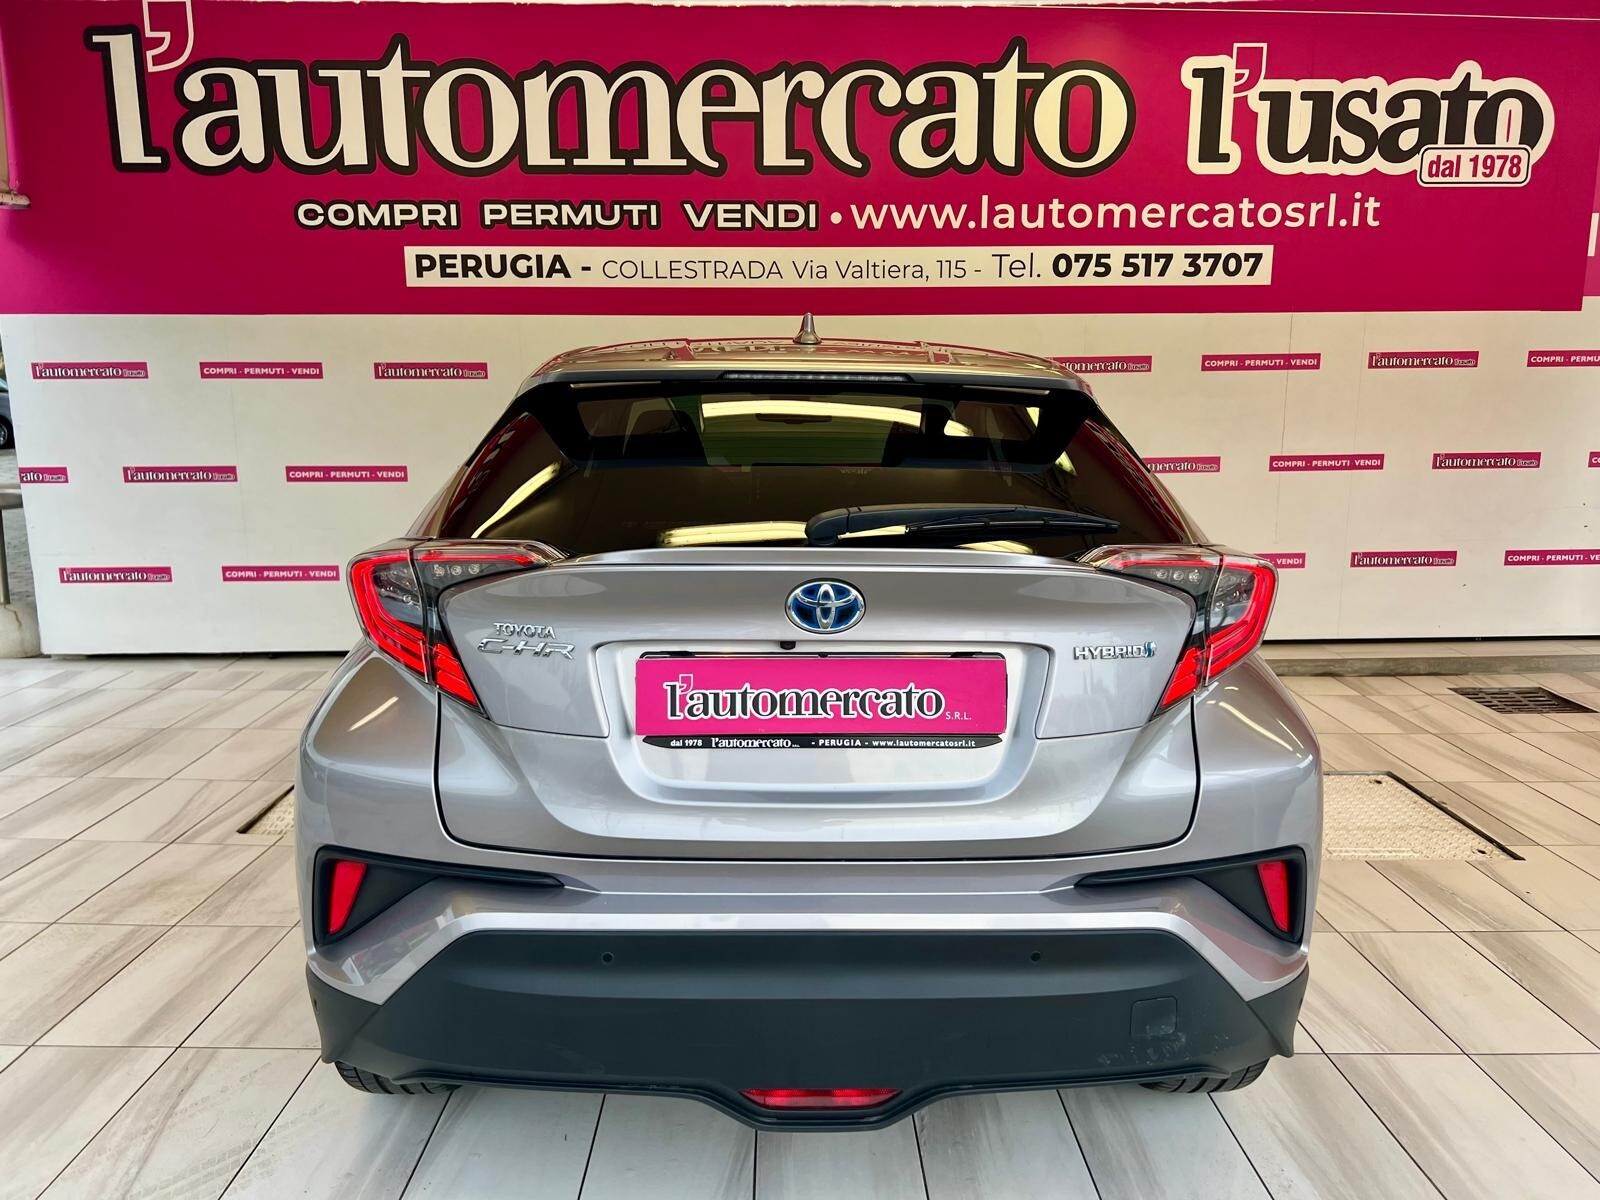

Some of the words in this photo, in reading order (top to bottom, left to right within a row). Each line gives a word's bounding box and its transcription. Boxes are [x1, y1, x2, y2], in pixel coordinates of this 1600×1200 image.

[88, 0, 1134, 172] l'automercato
[1185, 43, 1551, 170] l'usato
[1427, 157, 1461, 178] dal
[1469, 154, 1522, 178] 1978
[296, 201, 460, 229] COMPRI
[481, 202, 660, 228] PERMUTI
[682, 202, 818, 229] VENDI
[850, 192, 1381, 229] www.lautomercatosrl.it
[415, 253, 572, 279] PERUGIA
[602, 260, 784, 280] COLLESTRADA
[792, 259, 828, 279] Via
[835, 259, 930, 283] Valtiera,
[936, 259, 967, 279] 115
[991, 251, 1042, 279] Tel.
[1052, 252, 1112, 278] 075
[1121, 252, 1174, 278] 517
[1182, 252, 1264, 278] 3707
[203, 367, 237, 375] COMPRI
[244, 367, 285, 375] PERMUTI
[291, 367, 320, 375] VENDI
[1204, 359, 1239, 367] COMPRI
[1245, 359, 1284, 367] PERMUTI
[225, 570, 257, 578] COMPRI
[263, 570, 303, 578] PERMUTI
[493, 622, 556, 639] TOYOTA
[478, 638, 575, 660] C-HR
[1073, 645, 1145, 660] HYBRID
[664, 673, 945, 720] l'automercato
[945, 711, 972, 721] S.R.L.
[670, 739, 683, 747] dal
[684, 739, 703, 747] 1978
[711, 737, 792, 748] l'automercato
[818, 738, 862, 747] PERUGIA
